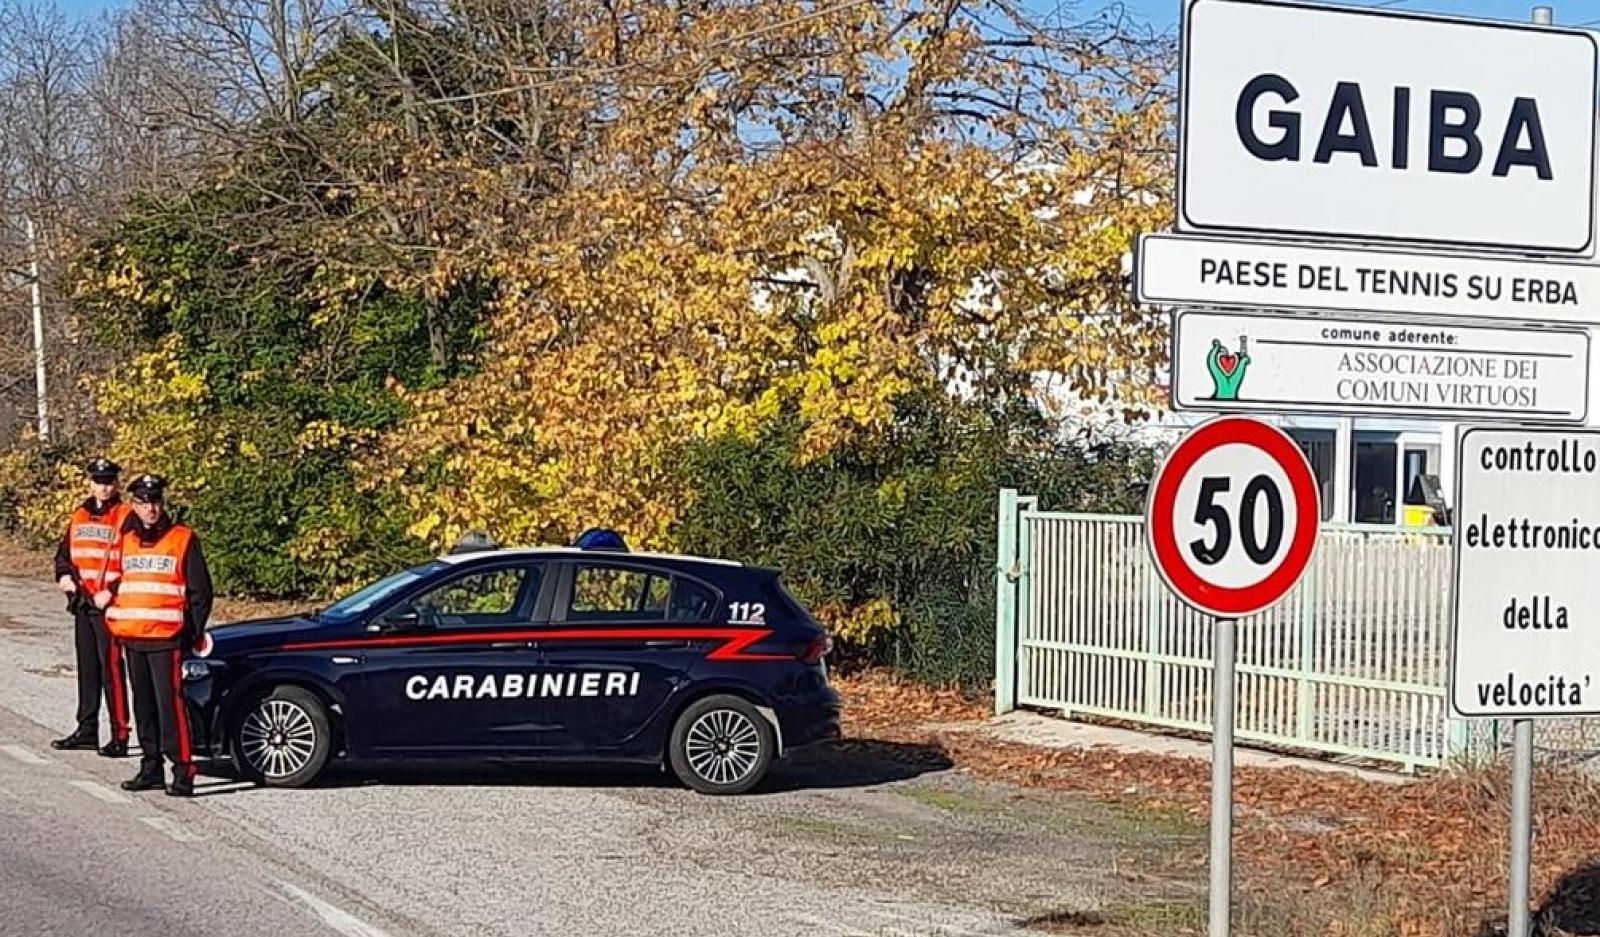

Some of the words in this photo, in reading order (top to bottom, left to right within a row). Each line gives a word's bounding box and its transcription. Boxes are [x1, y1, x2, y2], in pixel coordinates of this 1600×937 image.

[1235, 73, 1554, 181] GAIBA
[1200, 258, 1288, 289] PAESE
[1297, 264, 1348, 292] DEL
[1356, 268, 1458, 298] TENNIS
[1467, 274, 1502, 301] SU
[1511, 278, 1579, 305] ERBA
[1321, 326, 1381, 342] comune
[1388, 328, 1459, 345] aderente:
[1337, 352, 1497, 378] ASSOCIAZIONE
[1503, 359, 1538, 380] DEI
[1336, 379, 1429, 403] COMUNI
[1436, 383, 1537, 407] VIRTUOSI
[1480, 438, 1597, 473] controllo
[1189, 473, 1284, 566] 50
[727, 601, 765, 622] 112
[1502, 595, 1568, 630] della
[405, 672, 641, 700] CARABINIERI
[1477, 671, 1591, 706] velocita'
